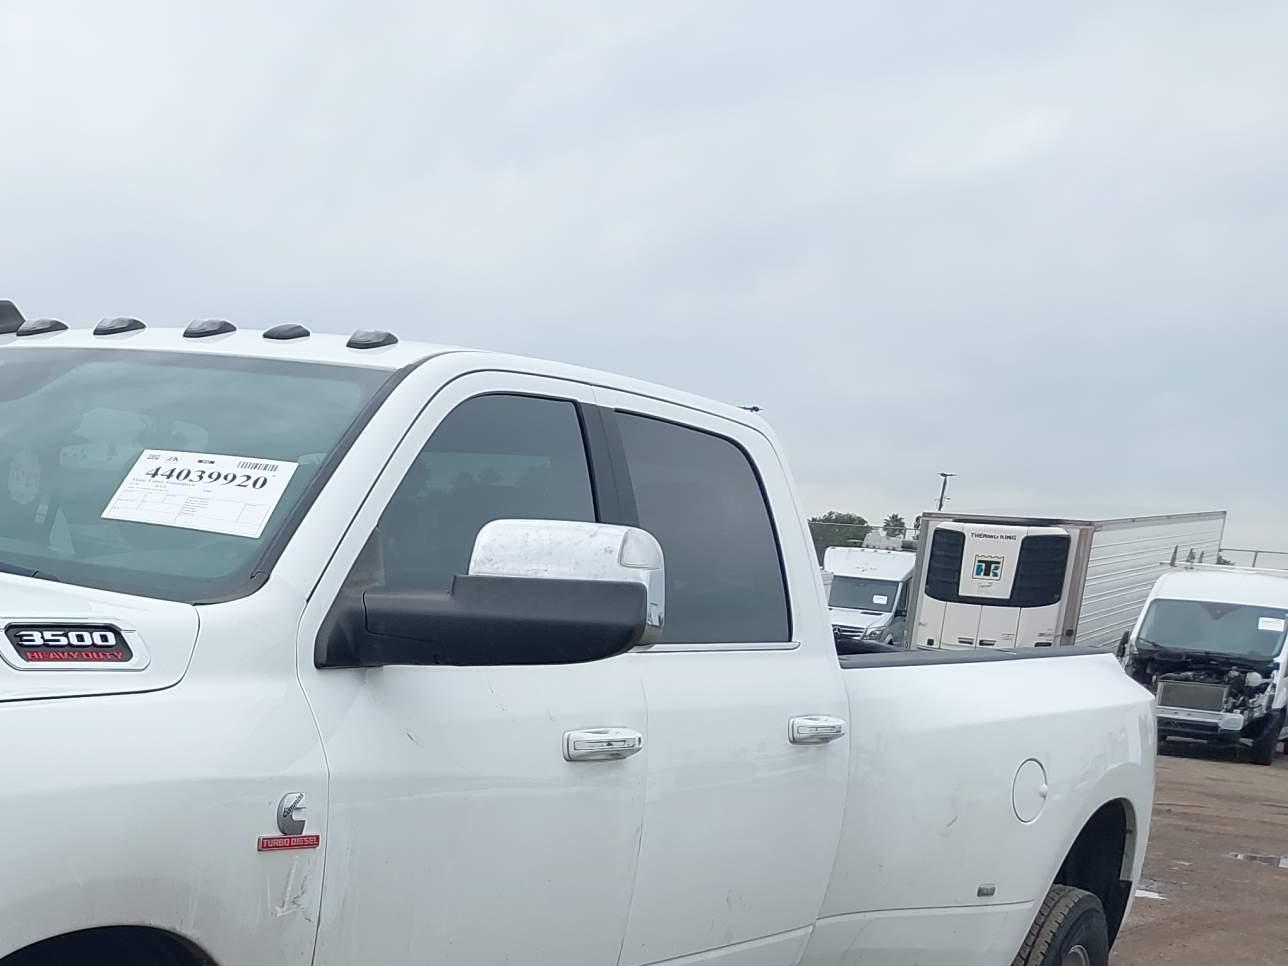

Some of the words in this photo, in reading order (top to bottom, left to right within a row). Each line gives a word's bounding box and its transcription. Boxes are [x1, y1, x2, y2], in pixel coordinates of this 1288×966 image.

[145, 465, 268, 490] 44039920
[15, 631, 116, 646] 3500
[25, 652, 77, 660] HEAVY
[81, 652, 124, 660] DUTY
[262, 839, 290, 847] TURBO
[291, 837, 318, 845] DIESEL
